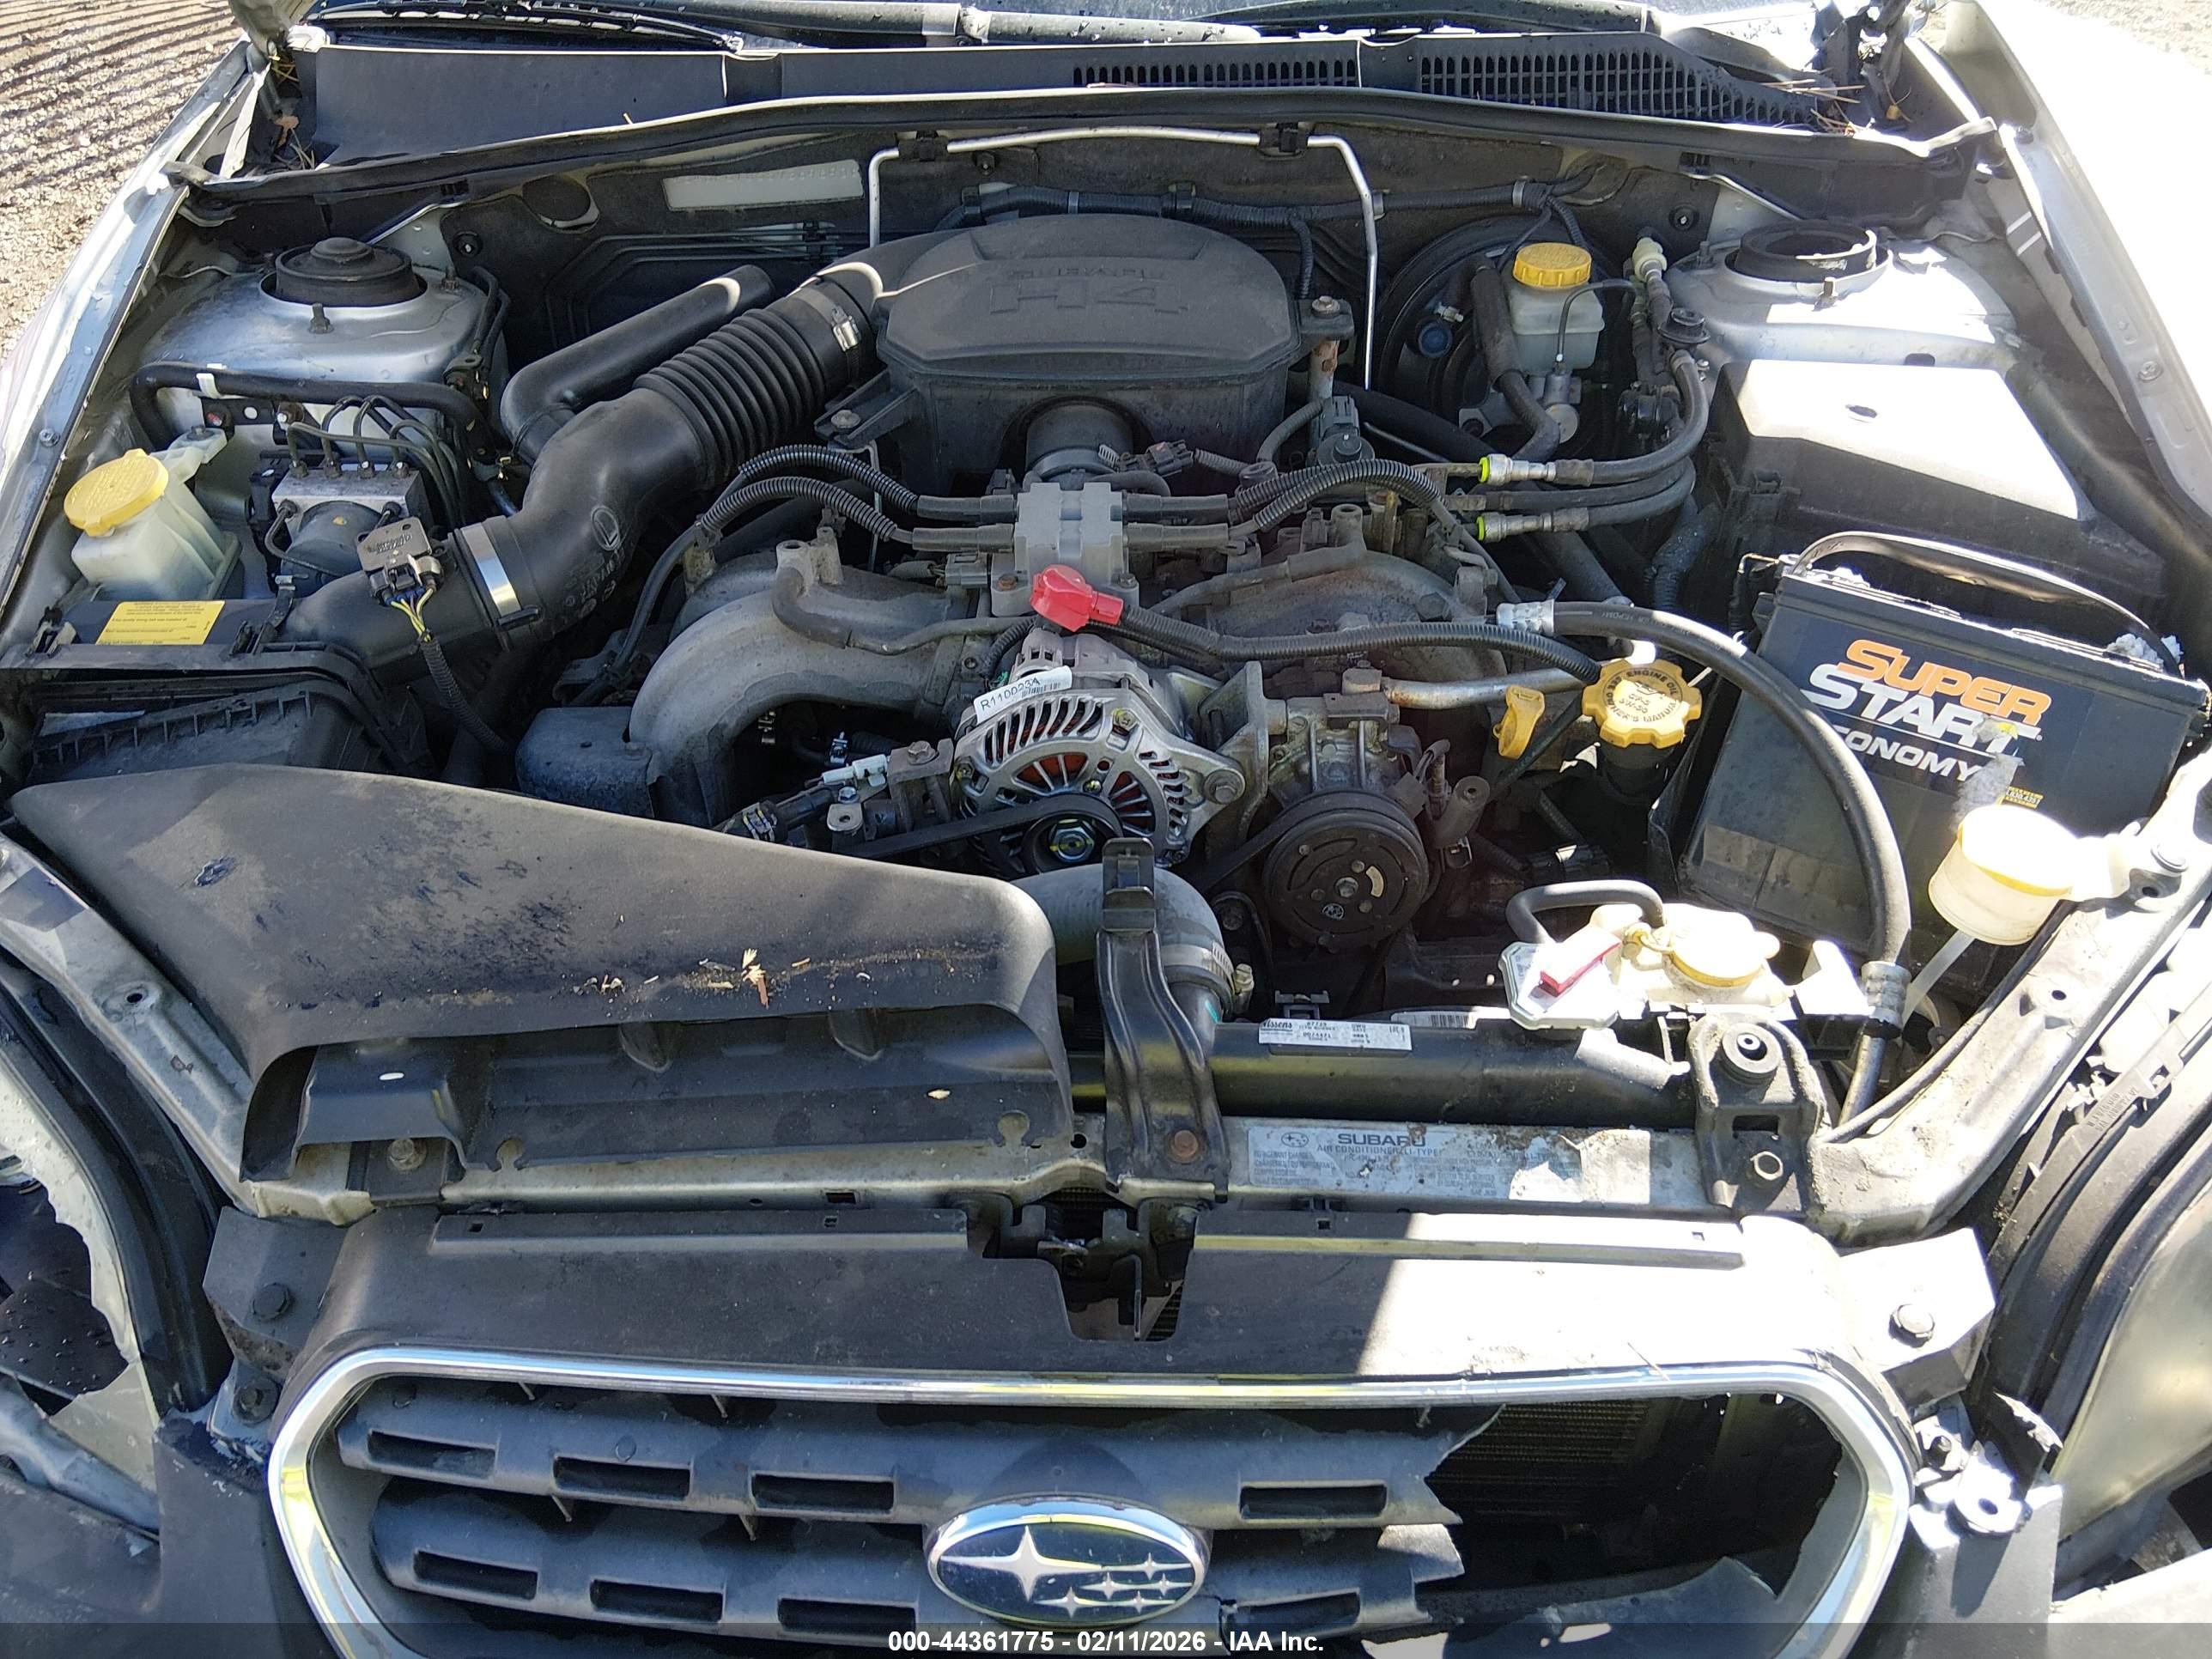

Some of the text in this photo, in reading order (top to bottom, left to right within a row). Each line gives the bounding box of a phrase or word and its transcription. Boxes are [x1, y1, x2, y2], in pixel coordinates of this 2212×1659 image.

[1626, 669, 1680, 696] ENGINE OIL
[1838, 639, 2052, 726] SUPER
[1643, 702, 1678, 722] MANUAL
[1800, 664, 2043, 753] START
[1832, 724, 1984, 782] ONOMY
[1316, 1144, 1333, 1152] AIR
[1337, 1133, 1426, 1147] SUBARU
